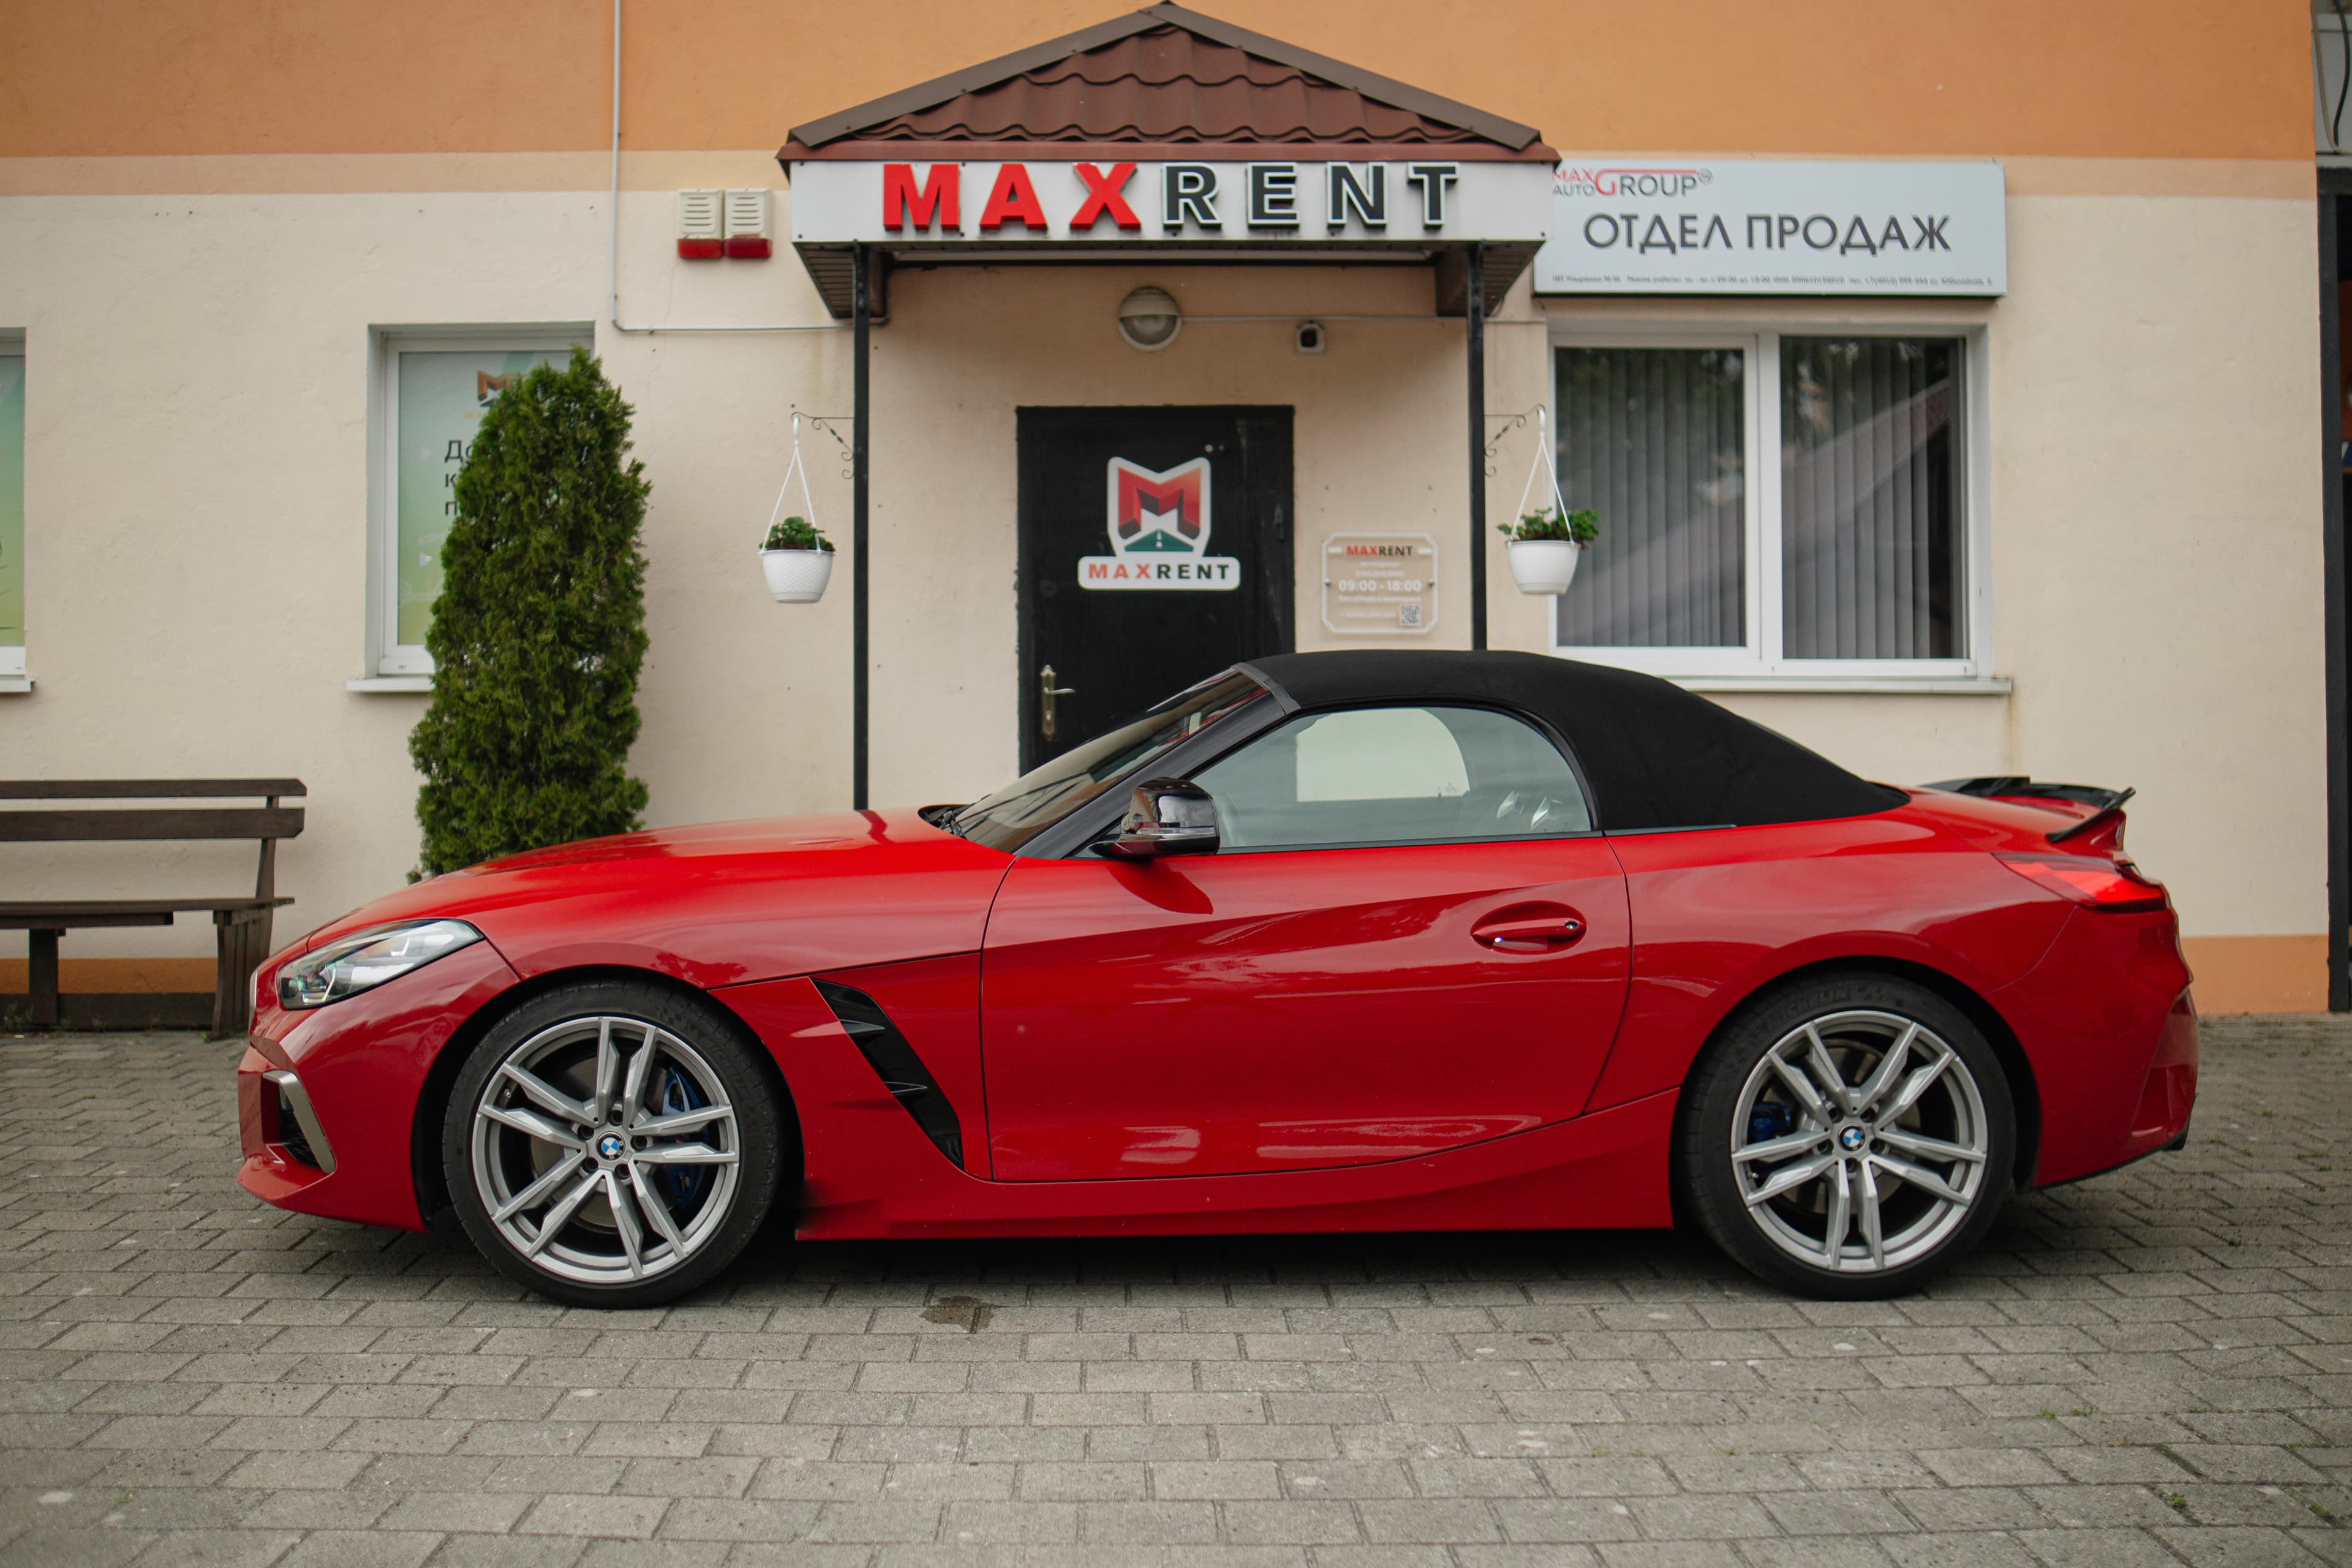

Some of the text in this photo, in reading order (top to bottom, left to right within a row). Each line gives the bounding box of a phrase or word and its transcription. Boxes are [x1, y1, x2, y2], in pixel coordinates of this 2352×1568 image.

[1553, 167, 1596, 183] MAX
[1596, 168, 1697, 197] GROUP
[883, 162, 1460, 231] MAXRENT
[1553, 183, 1596, 197] AUTO
[1583, 213, 1953, 256] ОТДЕЛ ПРОДАЖ
[1346, 545, 1414, 556] MAXRENT
[1088, 563, 1230, 579] MAXRENT
[1338, 579, 1377, 592] 09:00
[1387, 579, 1422, 592] 18:00
